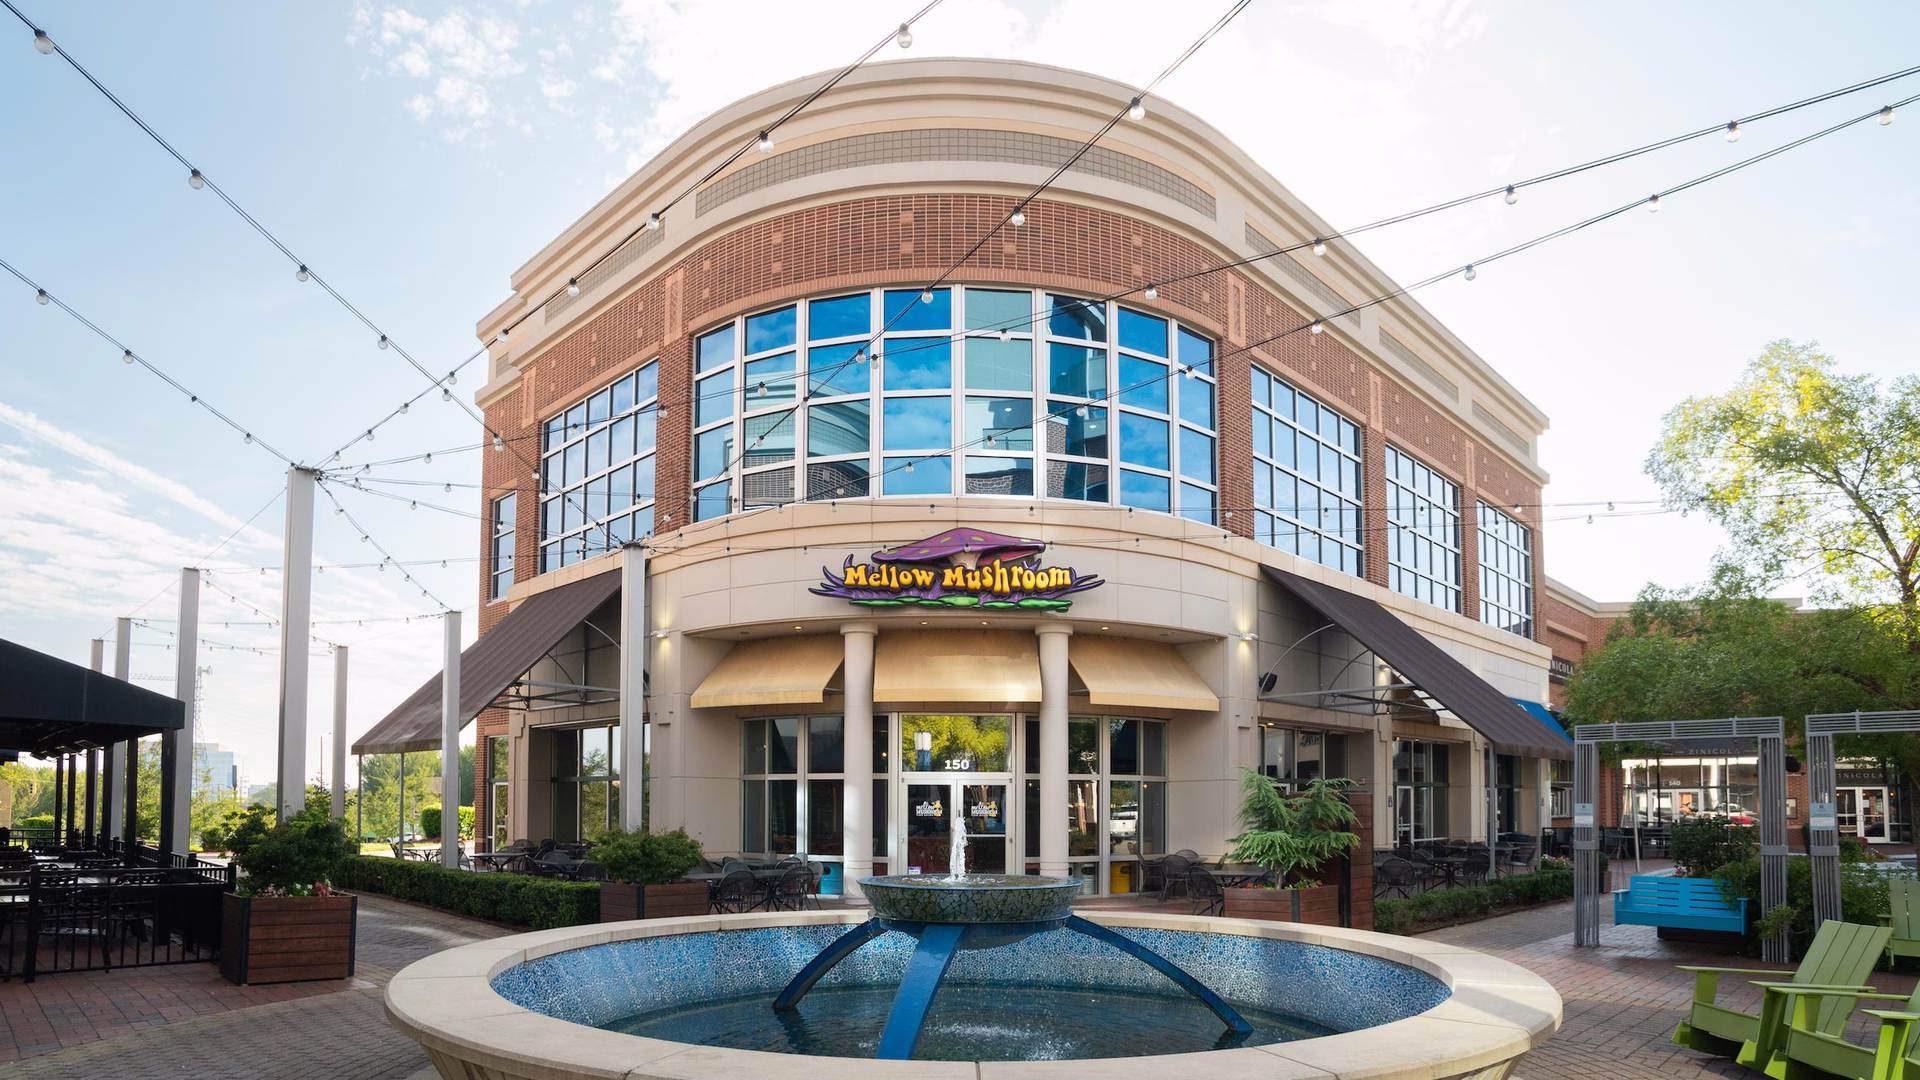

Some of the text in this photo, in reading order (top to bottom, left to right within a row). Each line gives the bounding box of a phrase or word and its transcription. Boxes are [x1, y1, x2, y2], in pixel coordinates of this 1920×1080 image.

[844, 559, 1071, 592] Mellow Mushroom
[1551, 659, 1575, 676] NICOLA
[944, 760, 970, 770] 150
